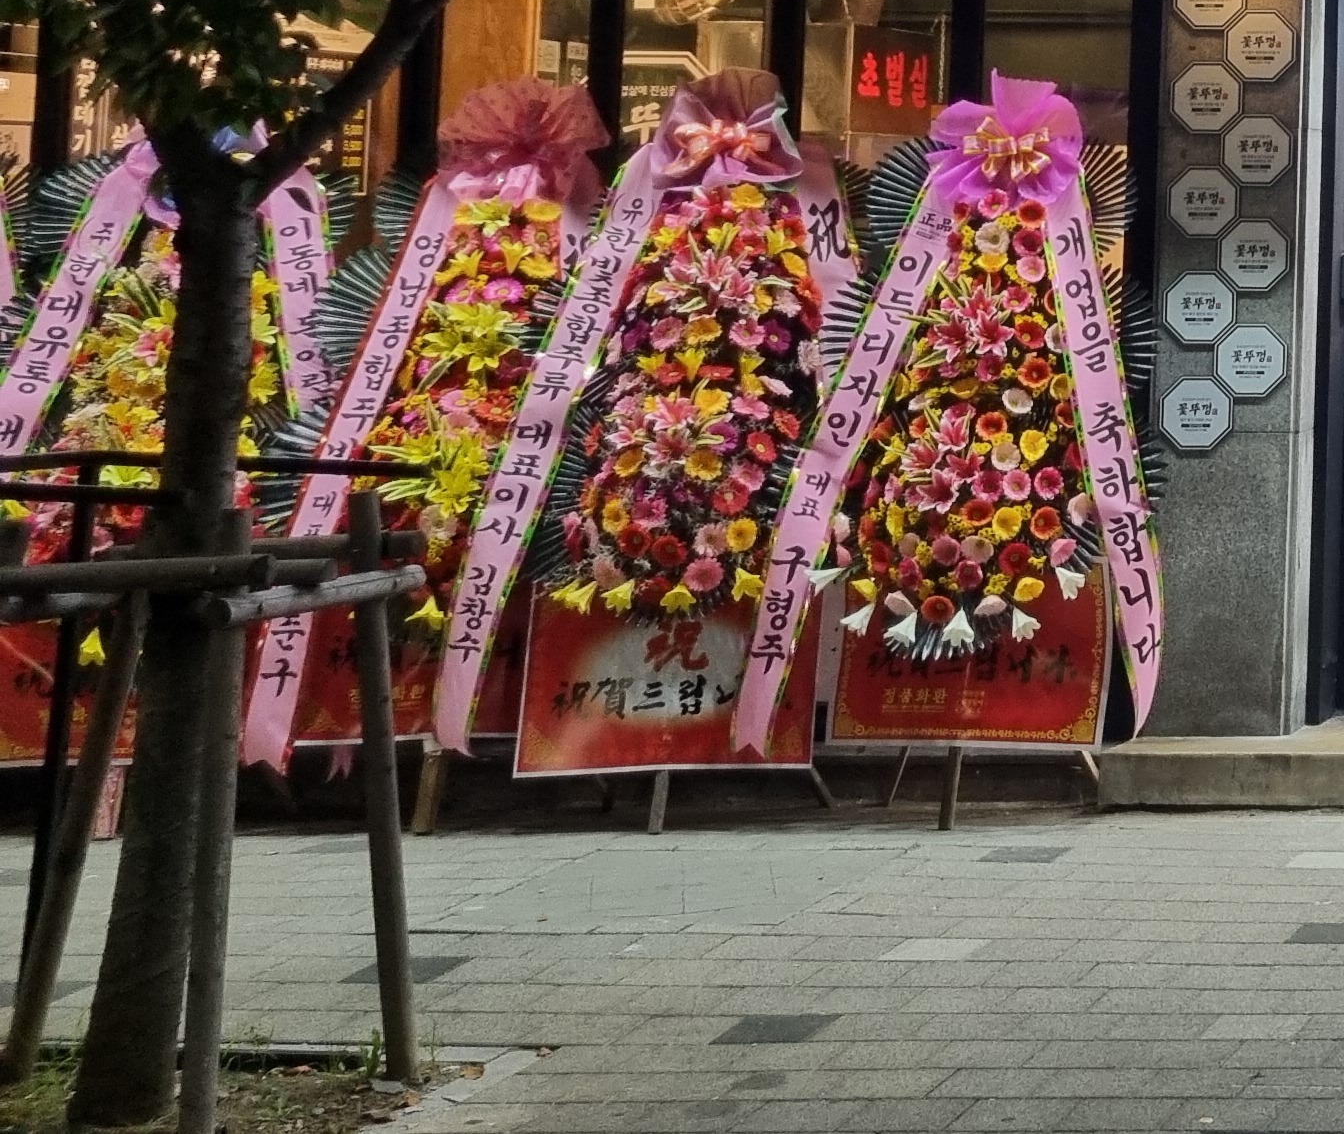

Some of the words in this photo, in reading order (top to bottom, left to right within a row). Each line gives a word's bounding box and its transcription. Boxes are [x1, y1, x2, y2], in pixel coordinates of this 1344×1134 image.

[827, 250, 934, 448] 이든디자인
[477, 419, 554, 546] 대표이사
[792, 470, 831, 521] 대표
[1056, 217, 1111, 373] 개업을
[1086, 401, 1161, 666] 축하합니다
[447, 564, 498, 664] 김창수
[750, 545, 811, 675] 구형주
